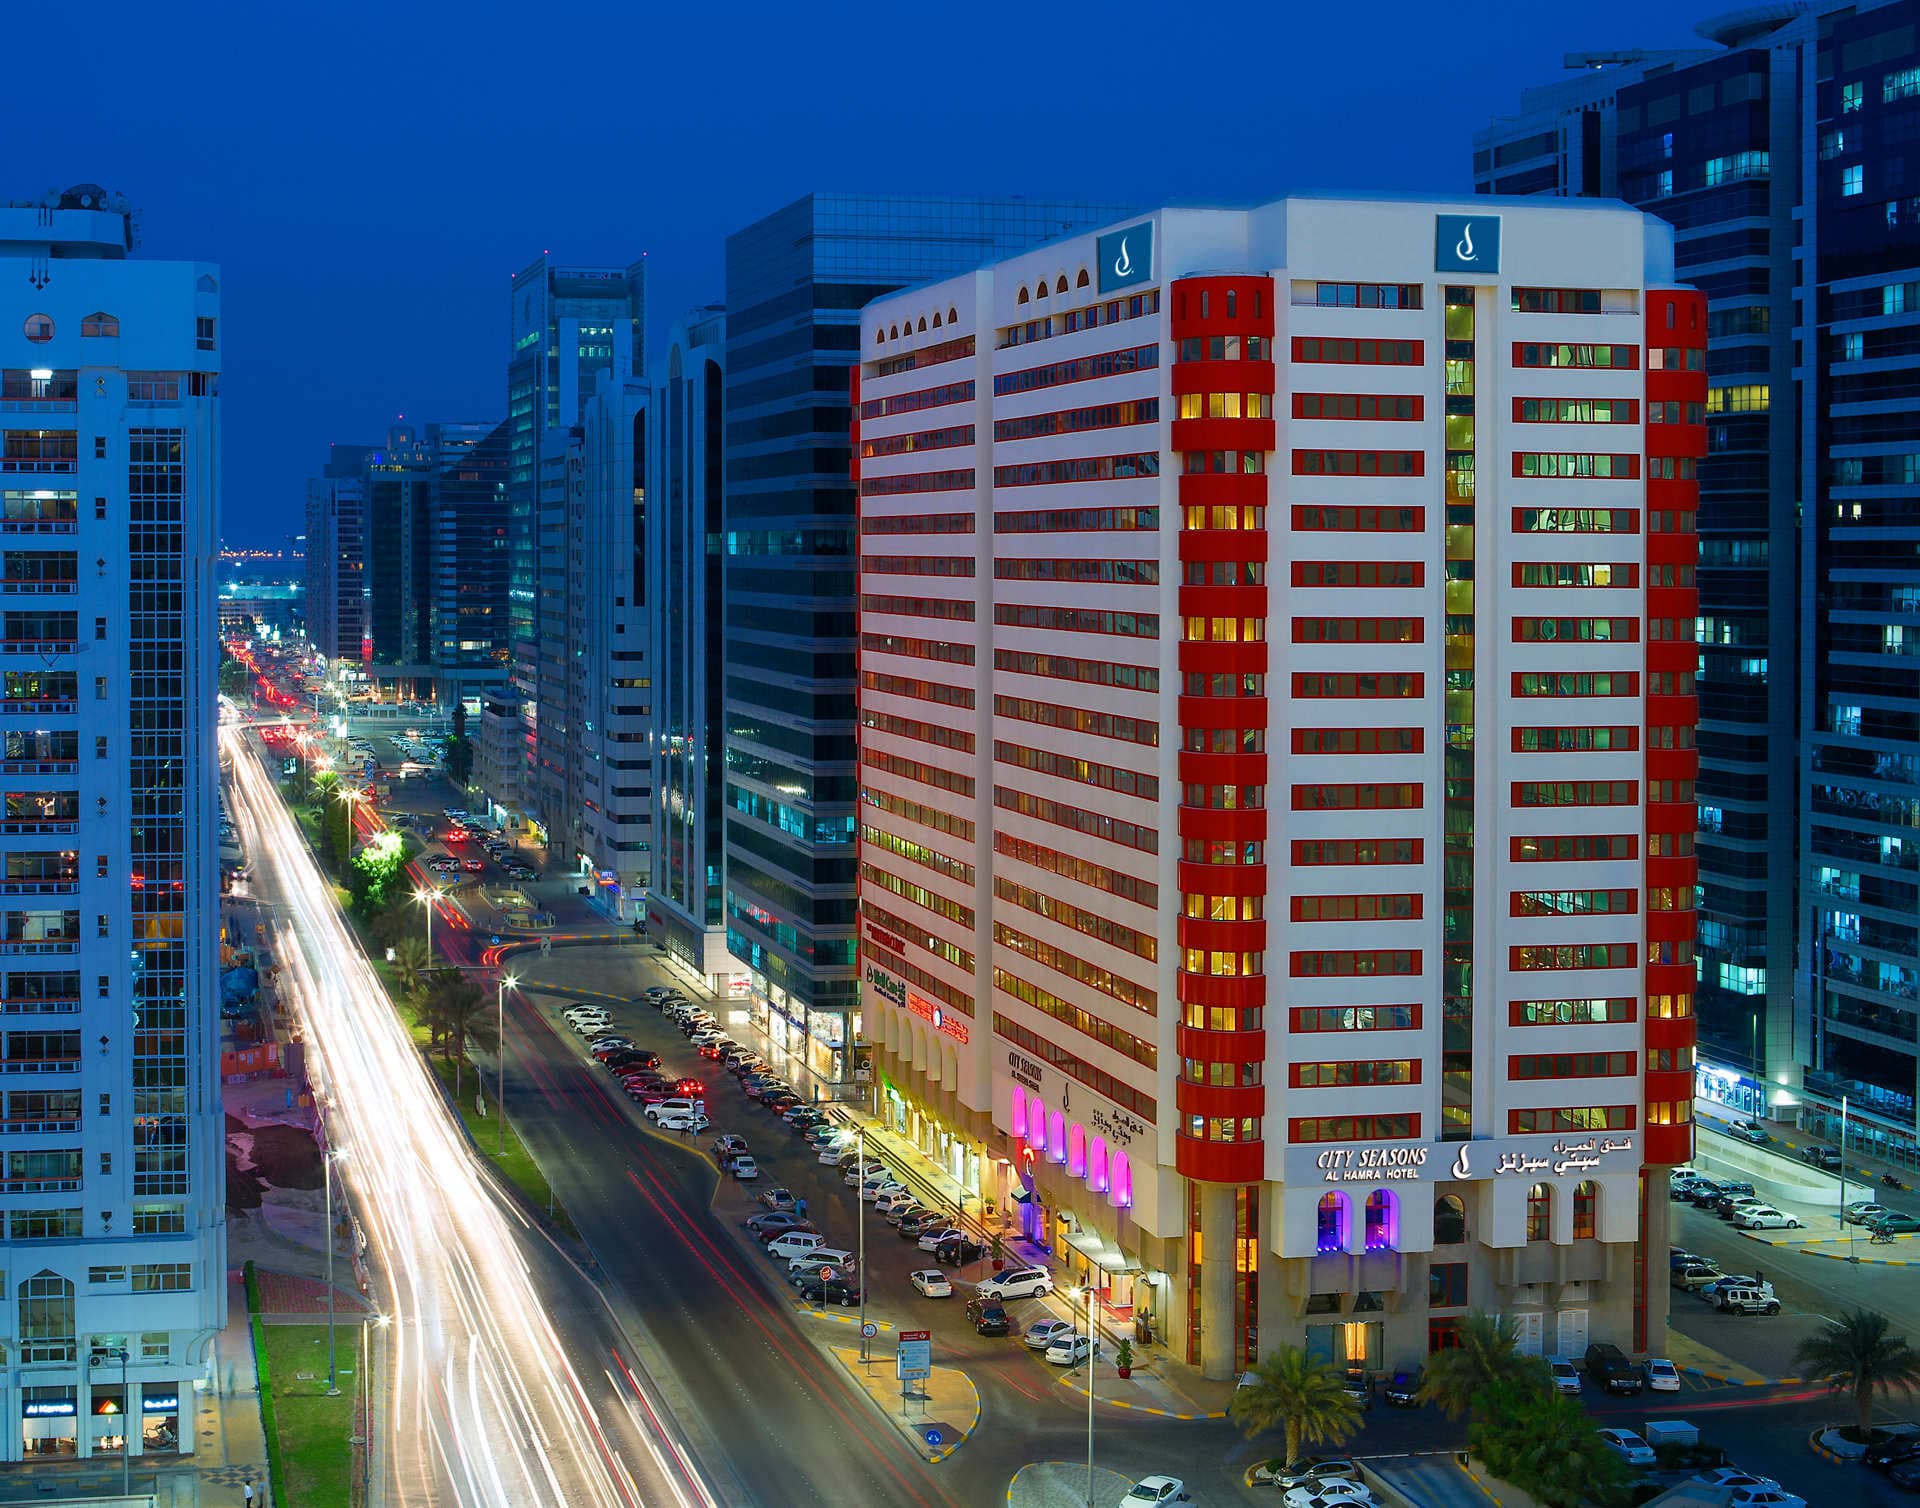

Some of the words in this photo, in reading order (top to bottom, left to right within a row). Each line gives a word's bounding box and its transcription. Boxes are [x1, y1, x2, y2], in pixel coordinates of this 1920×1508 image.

[1553, 1137, 1597, 1155] الحمراء
[1599, 1137, 1633, 1153] فندق
[1317, 1150, 1354, 1168] CITY
[1358, 1147, 1428, 1168] SEASONS
[1494, 1152, 1549, 1174] سيزنز
[1553, 1152, 1600, 1176] سيتي
[1325, 1172, 1339, 1181] AL
[1343, 1169, 1381, 1181] HAMRA
[1386, 1168, 1419, 1179] HOTEL
